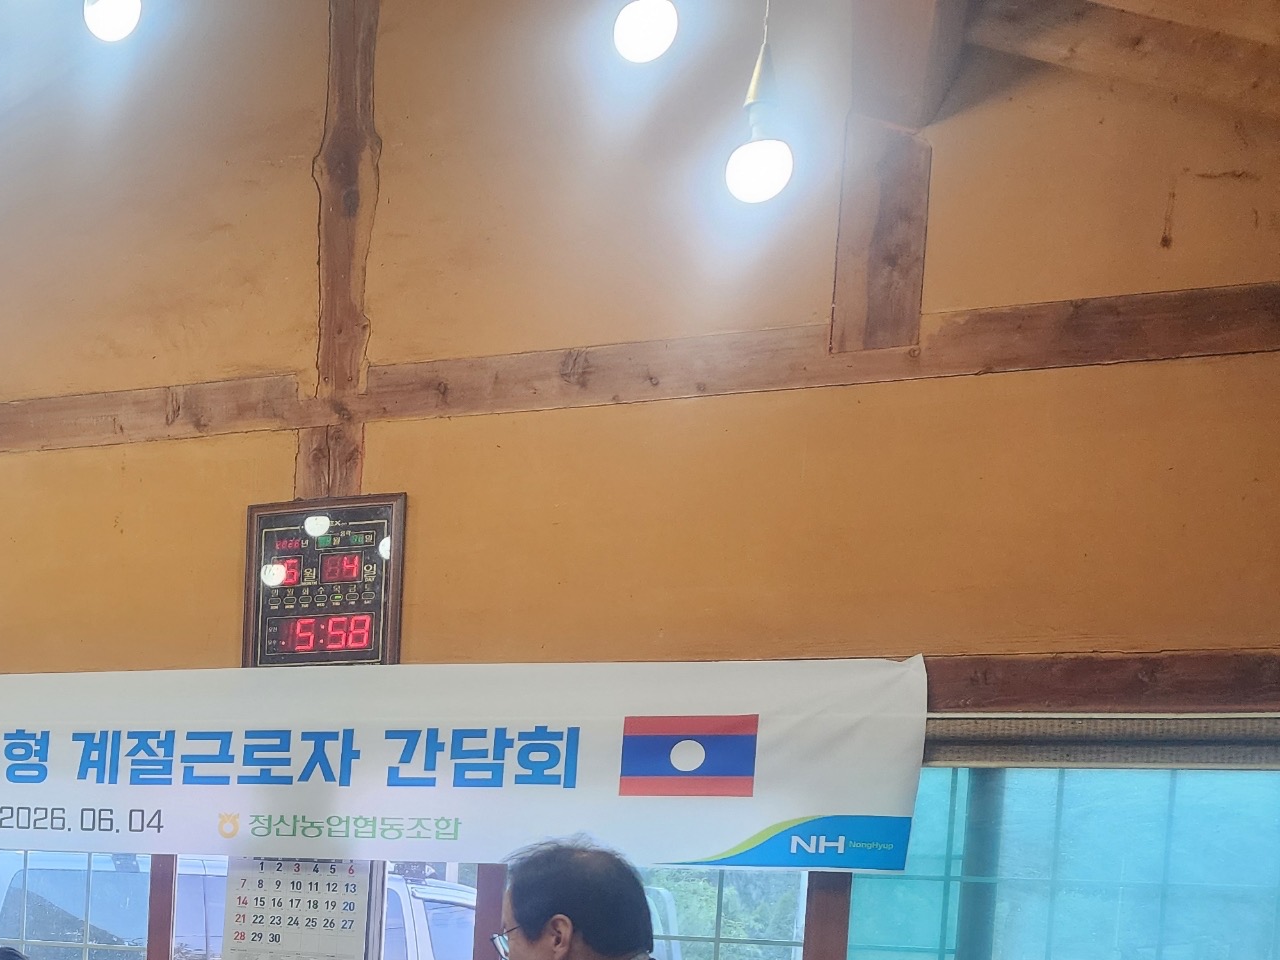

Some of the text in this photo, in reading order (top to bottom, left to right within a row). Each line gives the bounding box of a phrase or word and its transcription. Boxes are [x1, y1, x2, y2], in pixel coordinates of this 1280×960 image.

[303, 568, 316, 581] 월
[342, 555, 359, 578] 4
[364, 564, 376, 577] 일
[295, 615, 371, 651] 5:58
[73, 728, 360, 787] 계절근로자
[384, 726, 580, 790] 간담회
[249, 813, 462, 841] 정산농업협동조합
[790, 835, 894, 854] NH NongHyup
[259, 862, 354, 874] 1 2 3 4 5 6
[241, 879, 356, 893] 7 8 9 10 11 12 13
[237, 896, 355, 911] 14 15 16 17 18 19 20
[235, 914, 354, 929] 21 22 23 24 25 26 27
[234, 931, 280, 943] 28 29 30
